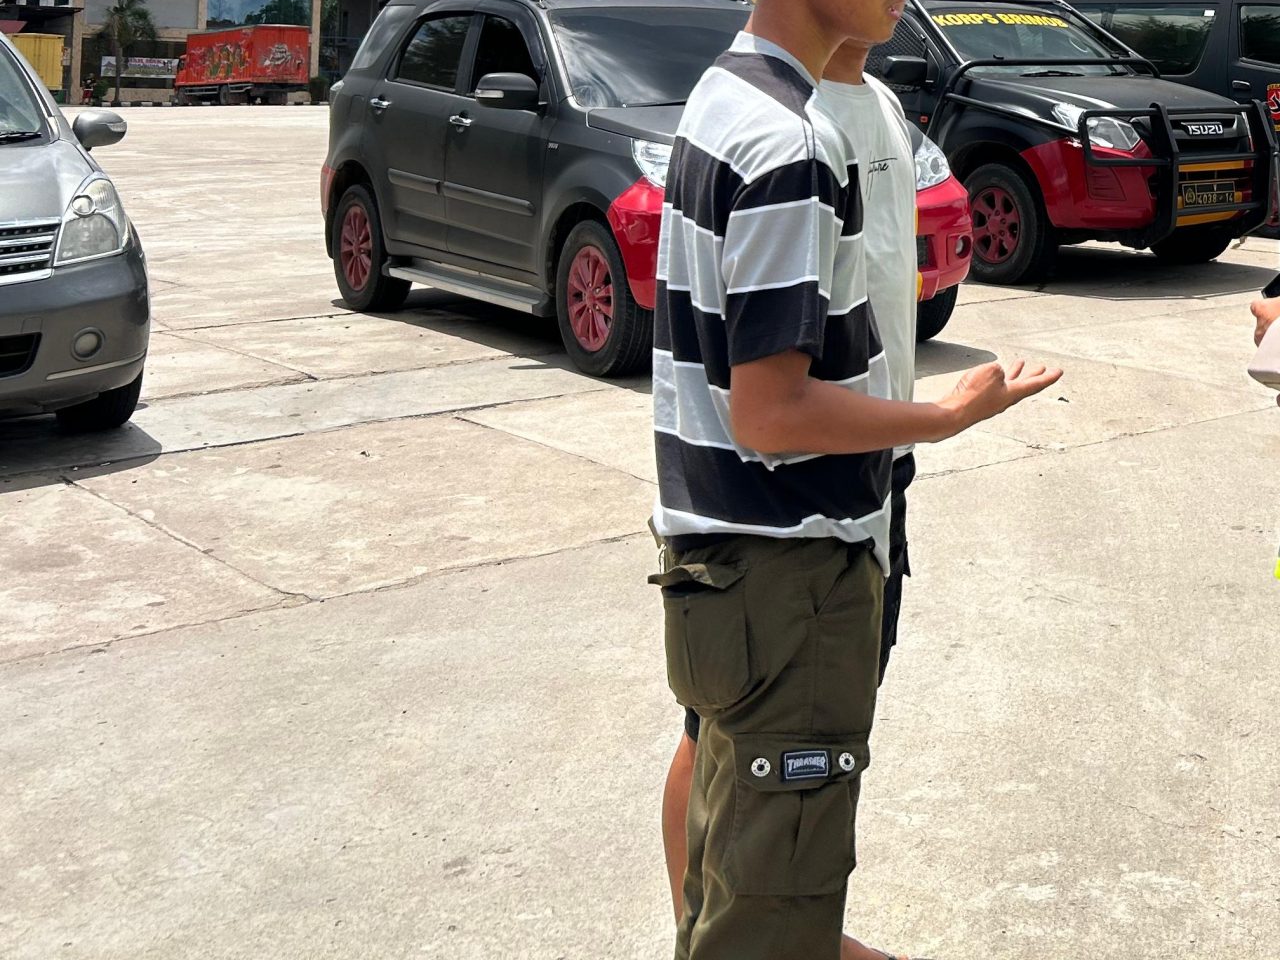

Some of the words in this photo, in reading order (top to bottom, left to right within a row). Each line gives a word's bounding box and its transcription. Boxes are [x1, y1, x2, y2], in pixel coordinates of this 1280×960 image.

[931, 13, 999, 27] KORPS
[996, 13, 1069, 28] BRIMOB
[1188, 125, 1224, 135] ISUZU
[787, 756, 826, 773] THRASHER
